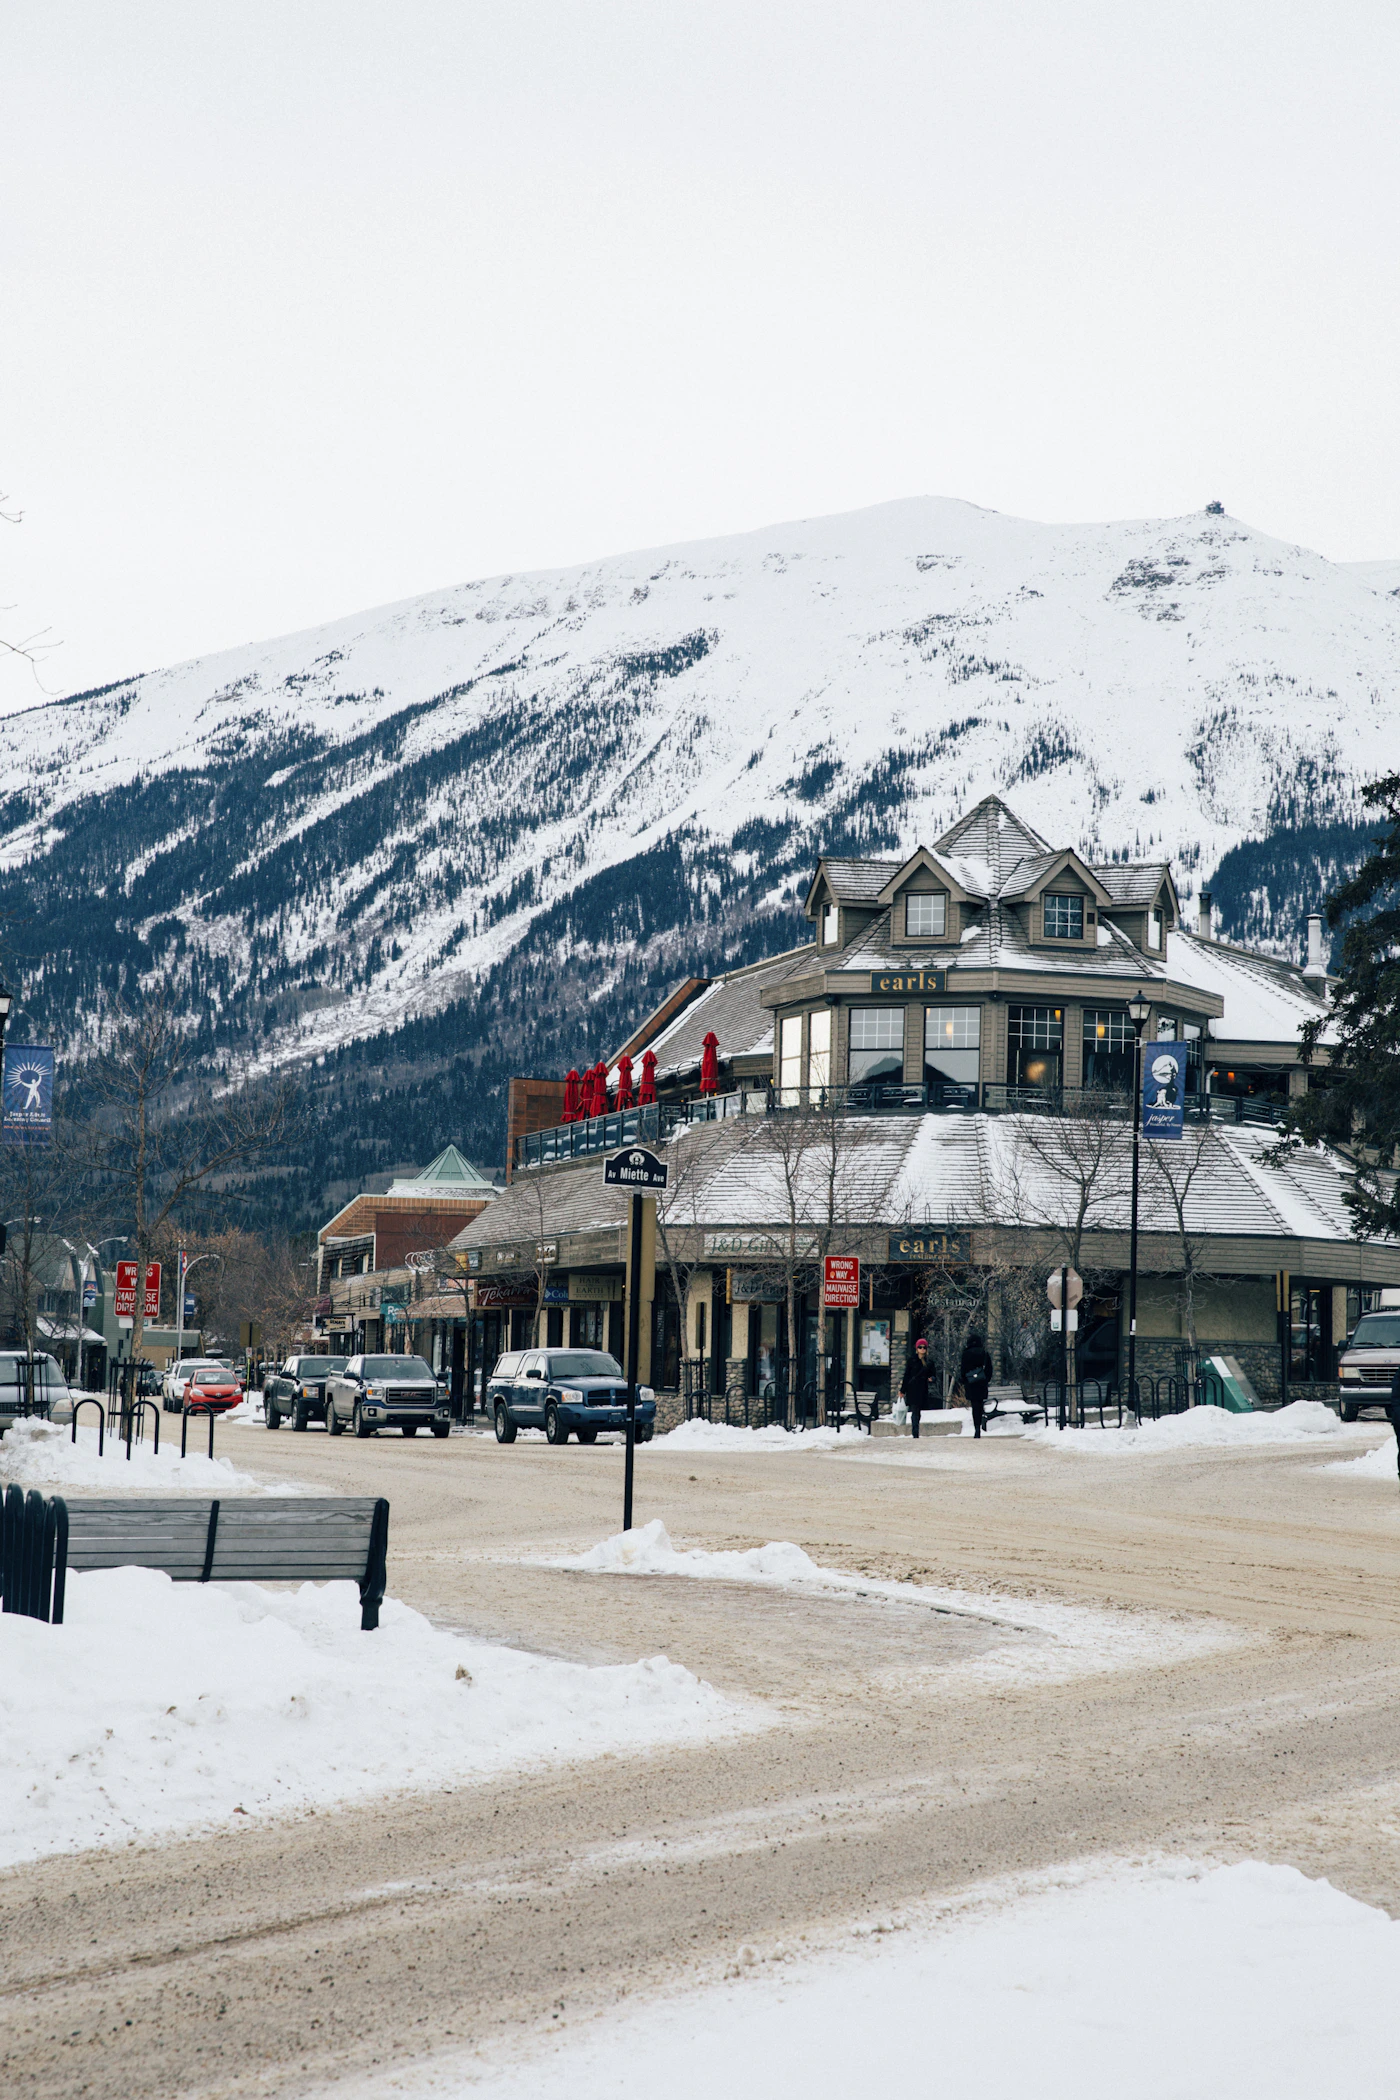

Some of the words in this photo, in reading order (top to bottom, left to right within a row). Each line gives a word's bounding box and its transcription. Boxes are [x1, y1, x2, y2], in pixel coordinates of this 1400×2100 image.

[880, 972, 937, 991] earls
[1145, 1113, 1175, 1127] jasper
[608, 1170, 616, 1178] Av
[620, 1167, 649, 1181] Miette
[653, 1173, 664, 1182] Ave
[899, 1235, 960, 1253] earls
[830, 1260, 854, 1271] WRONG
[124, 1266, 153, 1277] WRG
[835, 1270, 848, 1280] WAY
[826, 1283, 857, 1294] MAUVAISE
[117, 1291, 157, 1302] MAUSE
[478, 1286, 531, 1306] Tekarra
[825, 1293, 858, 1304] DIRECTION
[116, 1302, 158, 1313] DIREON
